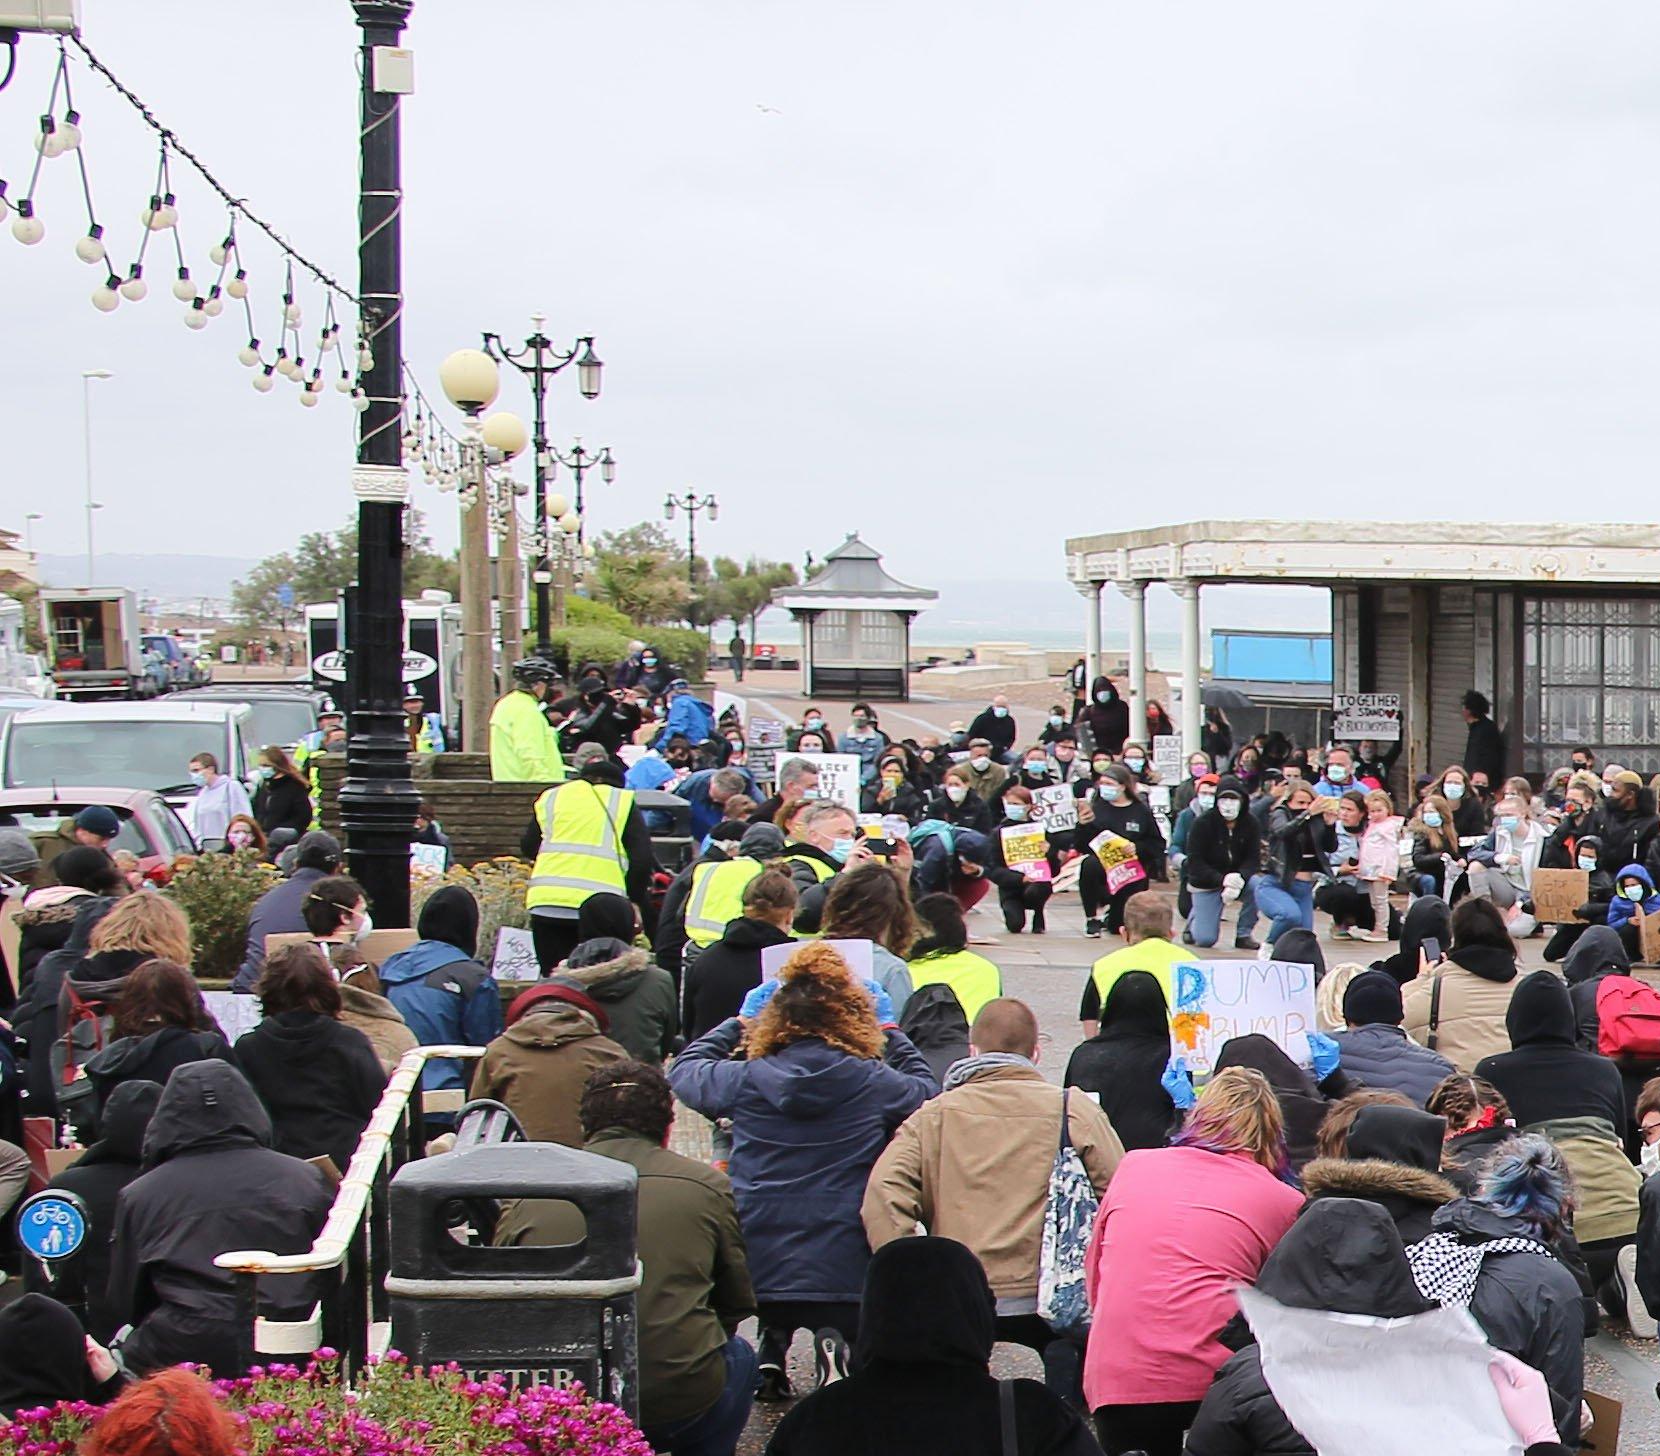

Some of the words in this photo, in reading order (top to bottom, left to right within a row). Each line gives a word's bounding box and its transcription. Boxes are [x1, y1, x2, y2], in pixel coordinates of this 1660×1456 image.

[1336, 695, 1398, 707] TOGETHER
[1358, 707, 1385, 717] STAND
[1054, 790, 1064, 800] IS
[1177, 964, 1308, 1008] DUMP
